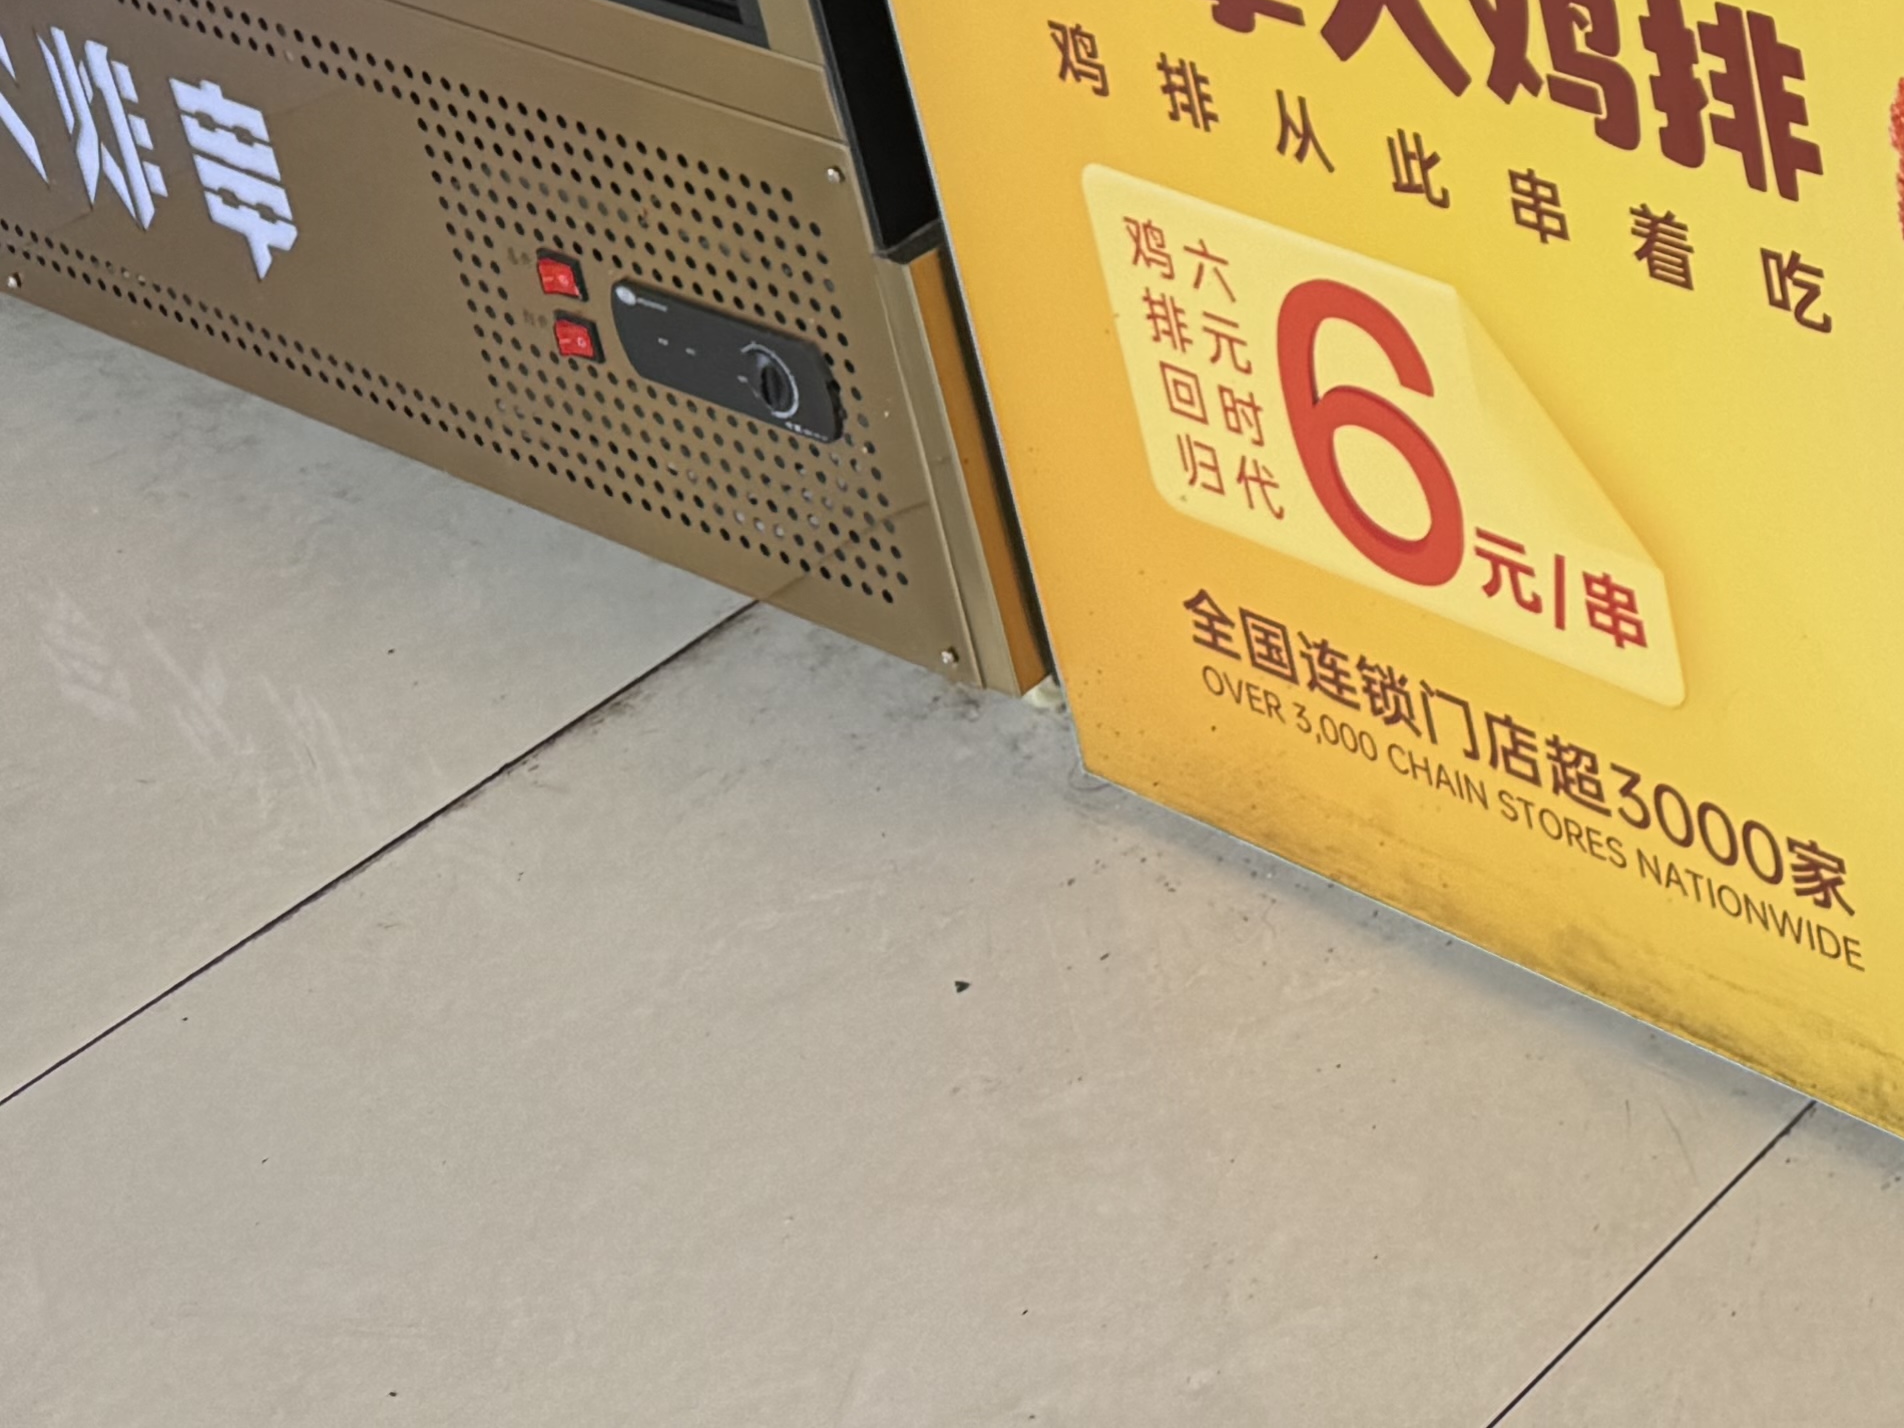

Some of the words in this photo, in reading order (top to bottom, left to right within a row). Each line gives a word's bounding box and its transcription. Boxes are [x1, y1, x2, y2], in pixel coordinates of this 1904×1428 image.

[1047, 20, 1833, 334] 鸡排从此串着吃
[1122, 215, 1225, 501] 鸡排回归
[1183, 239, 1285, 522] 六元时代
[1277, 278, 1464, 587] 6
[1183, 589, 1857, 918] 全国连锁门店超3000家
[1203, 663, 1285, 726] OVER
[1295, 710, 1380, 764] 3,000
[1388, 744, 1490, 812] CHAIN
[1499, 789, 1628, 871] STORES
[1637, 847, 1866, 974] NATIONWIDE
